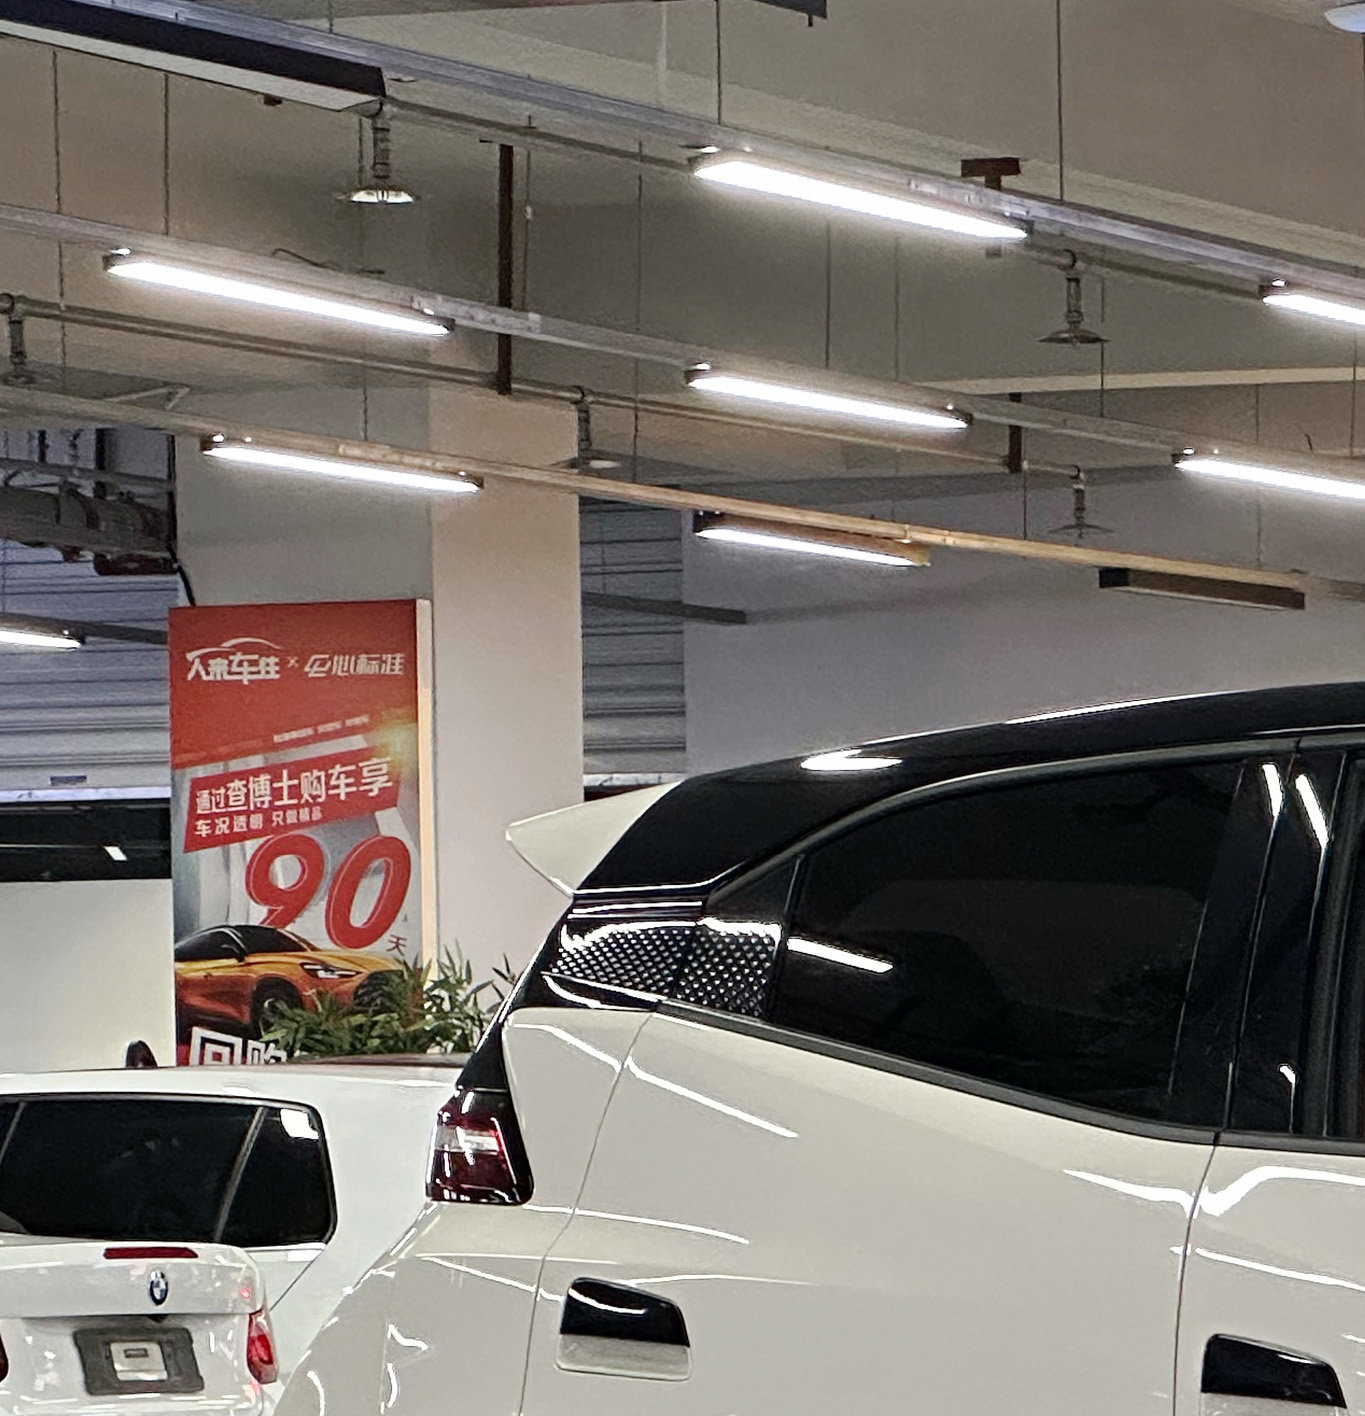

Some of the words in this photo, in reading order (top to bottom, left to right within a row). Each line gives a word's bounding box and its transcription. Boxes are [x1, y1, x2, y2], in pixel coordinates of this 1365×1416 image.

[196, 757, 394, 816] 通过查博士购车享
[245, 835, 412, 950] 90
[387, 934, 408, 956] 天
